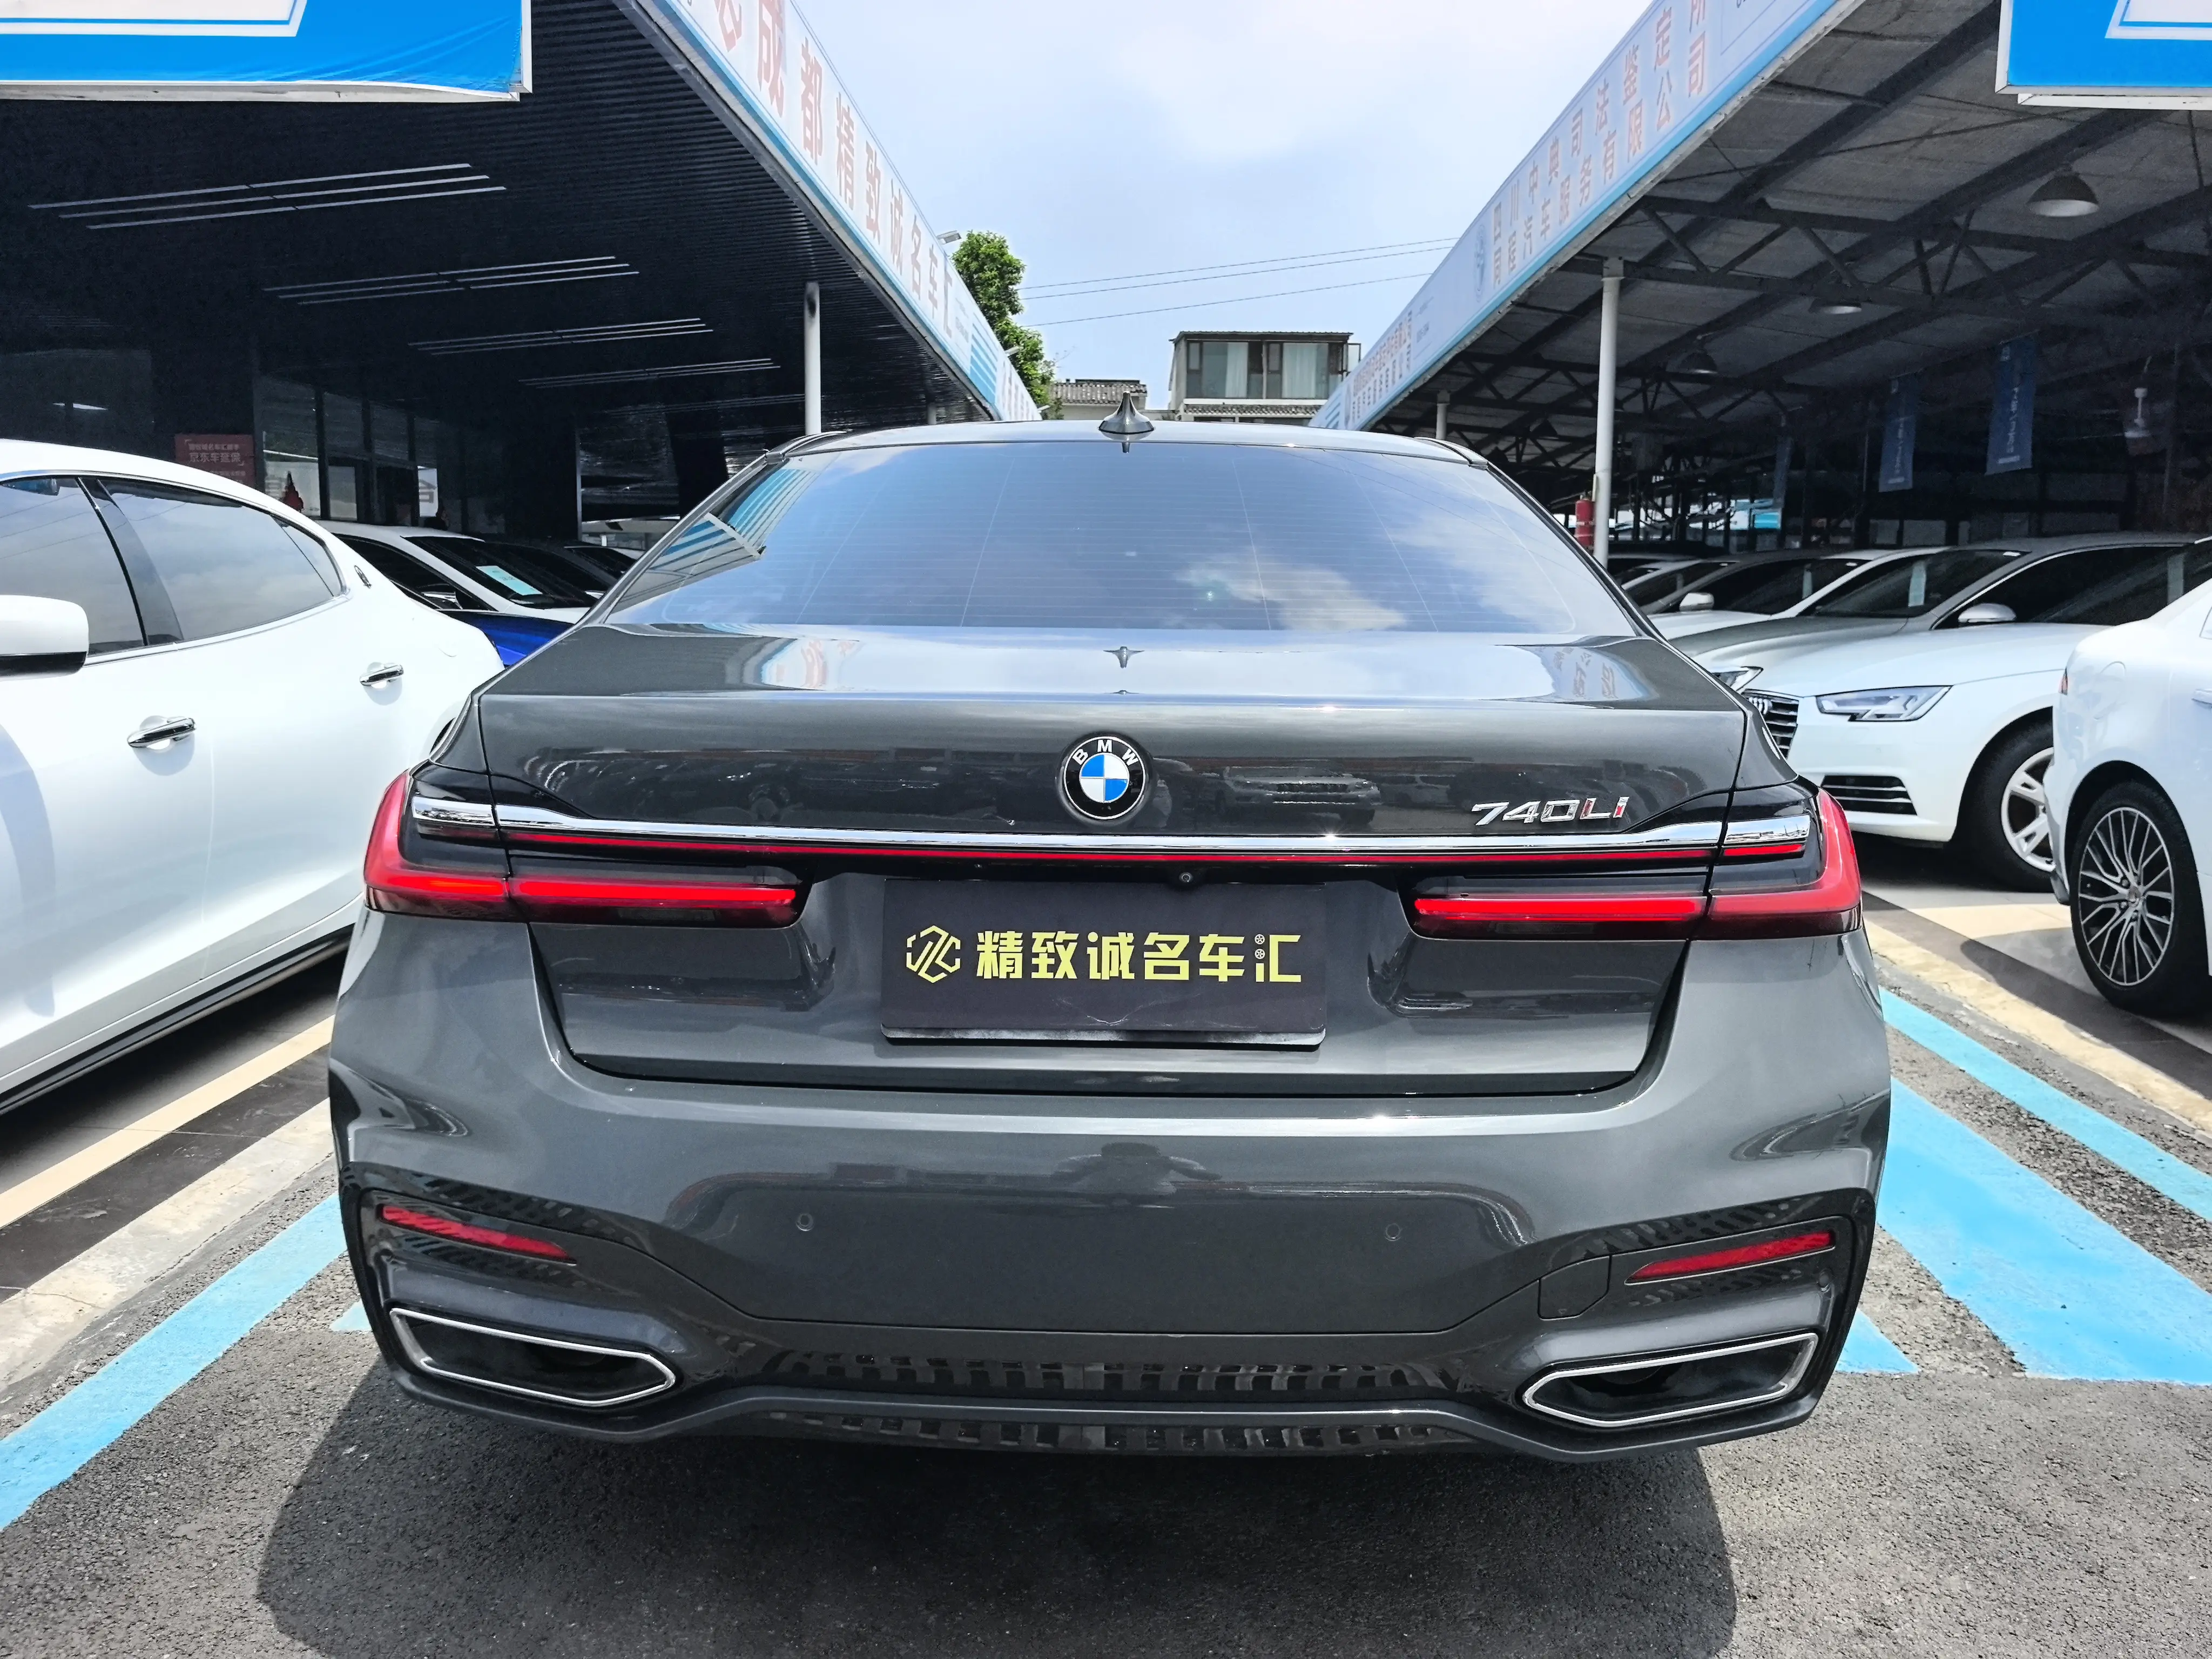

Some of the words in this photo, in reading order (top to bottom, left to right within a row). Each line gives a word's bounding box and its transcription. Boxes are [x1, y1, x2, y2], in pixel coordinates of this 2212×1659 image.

[1072, 739, 1139, 766] BMW
[976, 930, 1302, 983] 精致诚名车汇
